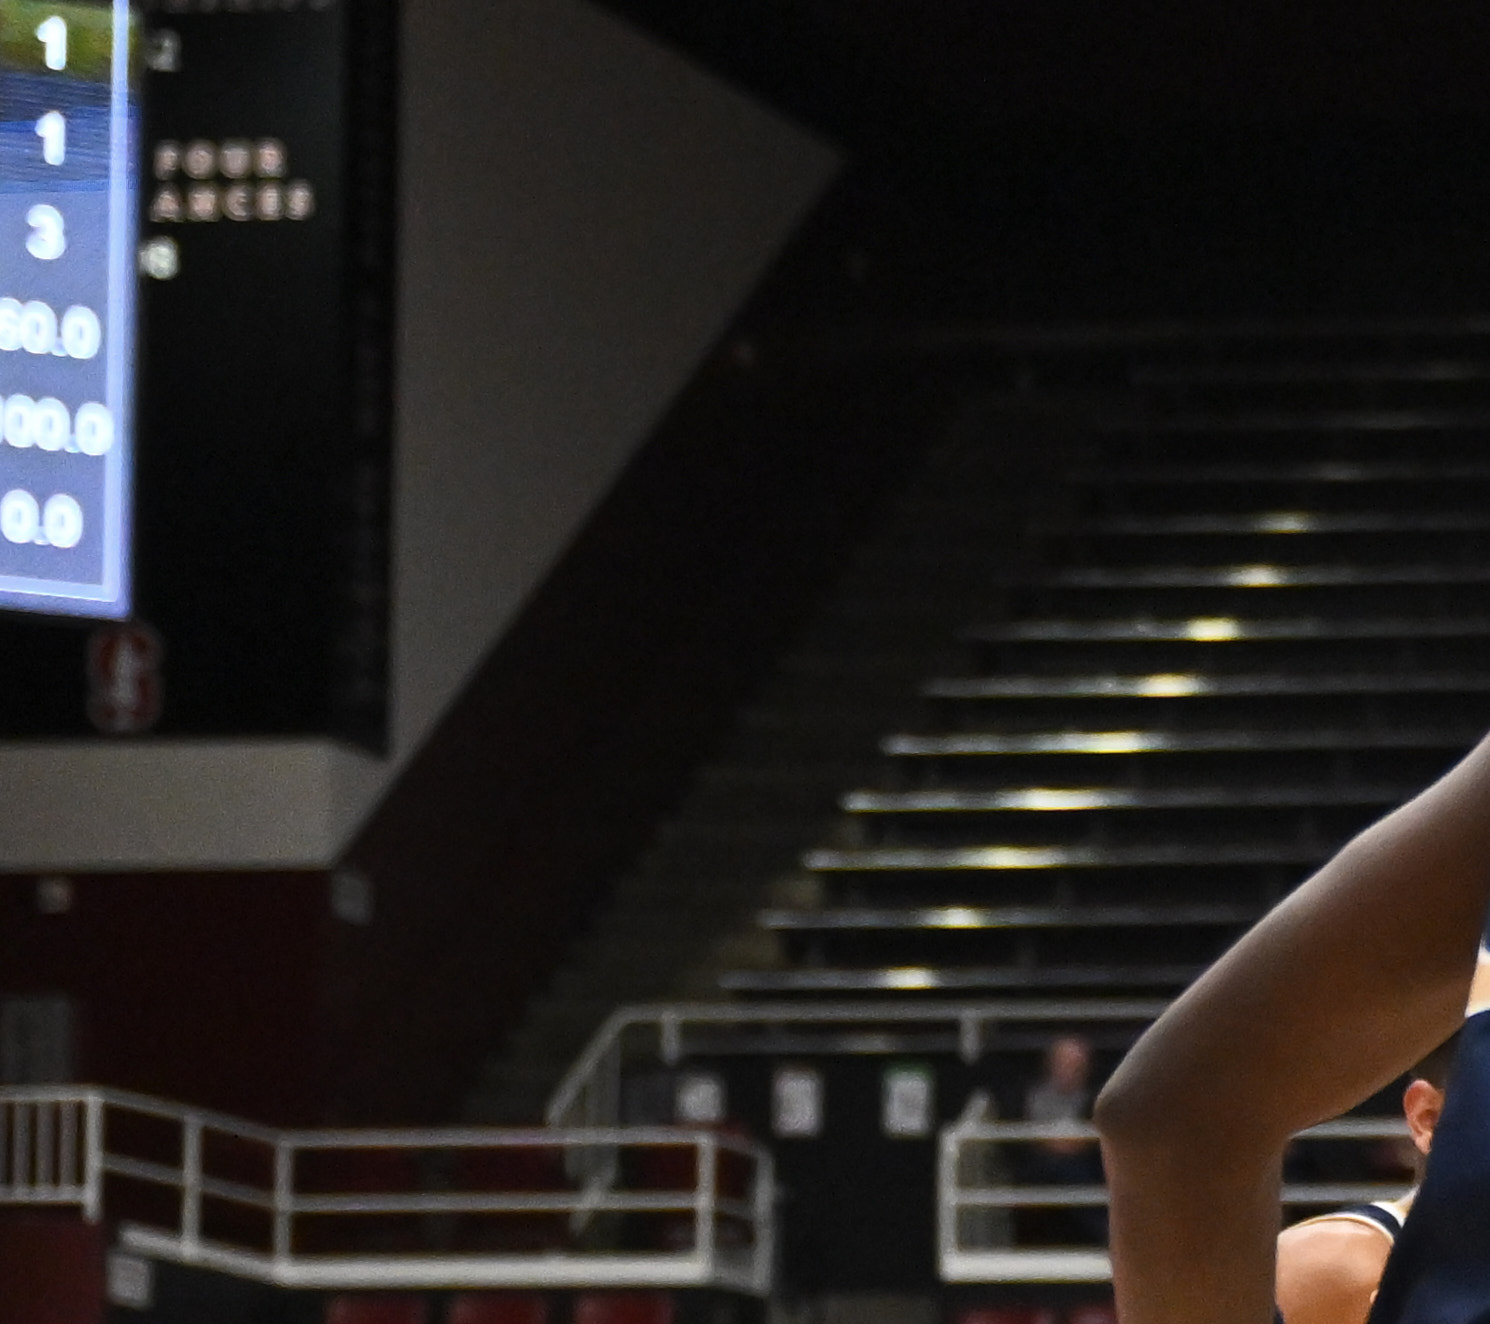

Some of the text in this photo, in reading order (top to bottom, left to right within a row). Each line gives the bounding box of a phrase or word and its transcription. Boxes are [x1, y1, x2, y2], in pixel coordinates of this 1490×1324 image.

[35, 15, 68, 71] 1
[34, 110, 67, 166] 1
[25, 203, 68, 260] 3
[0, 393, 115, 456] 00.0
